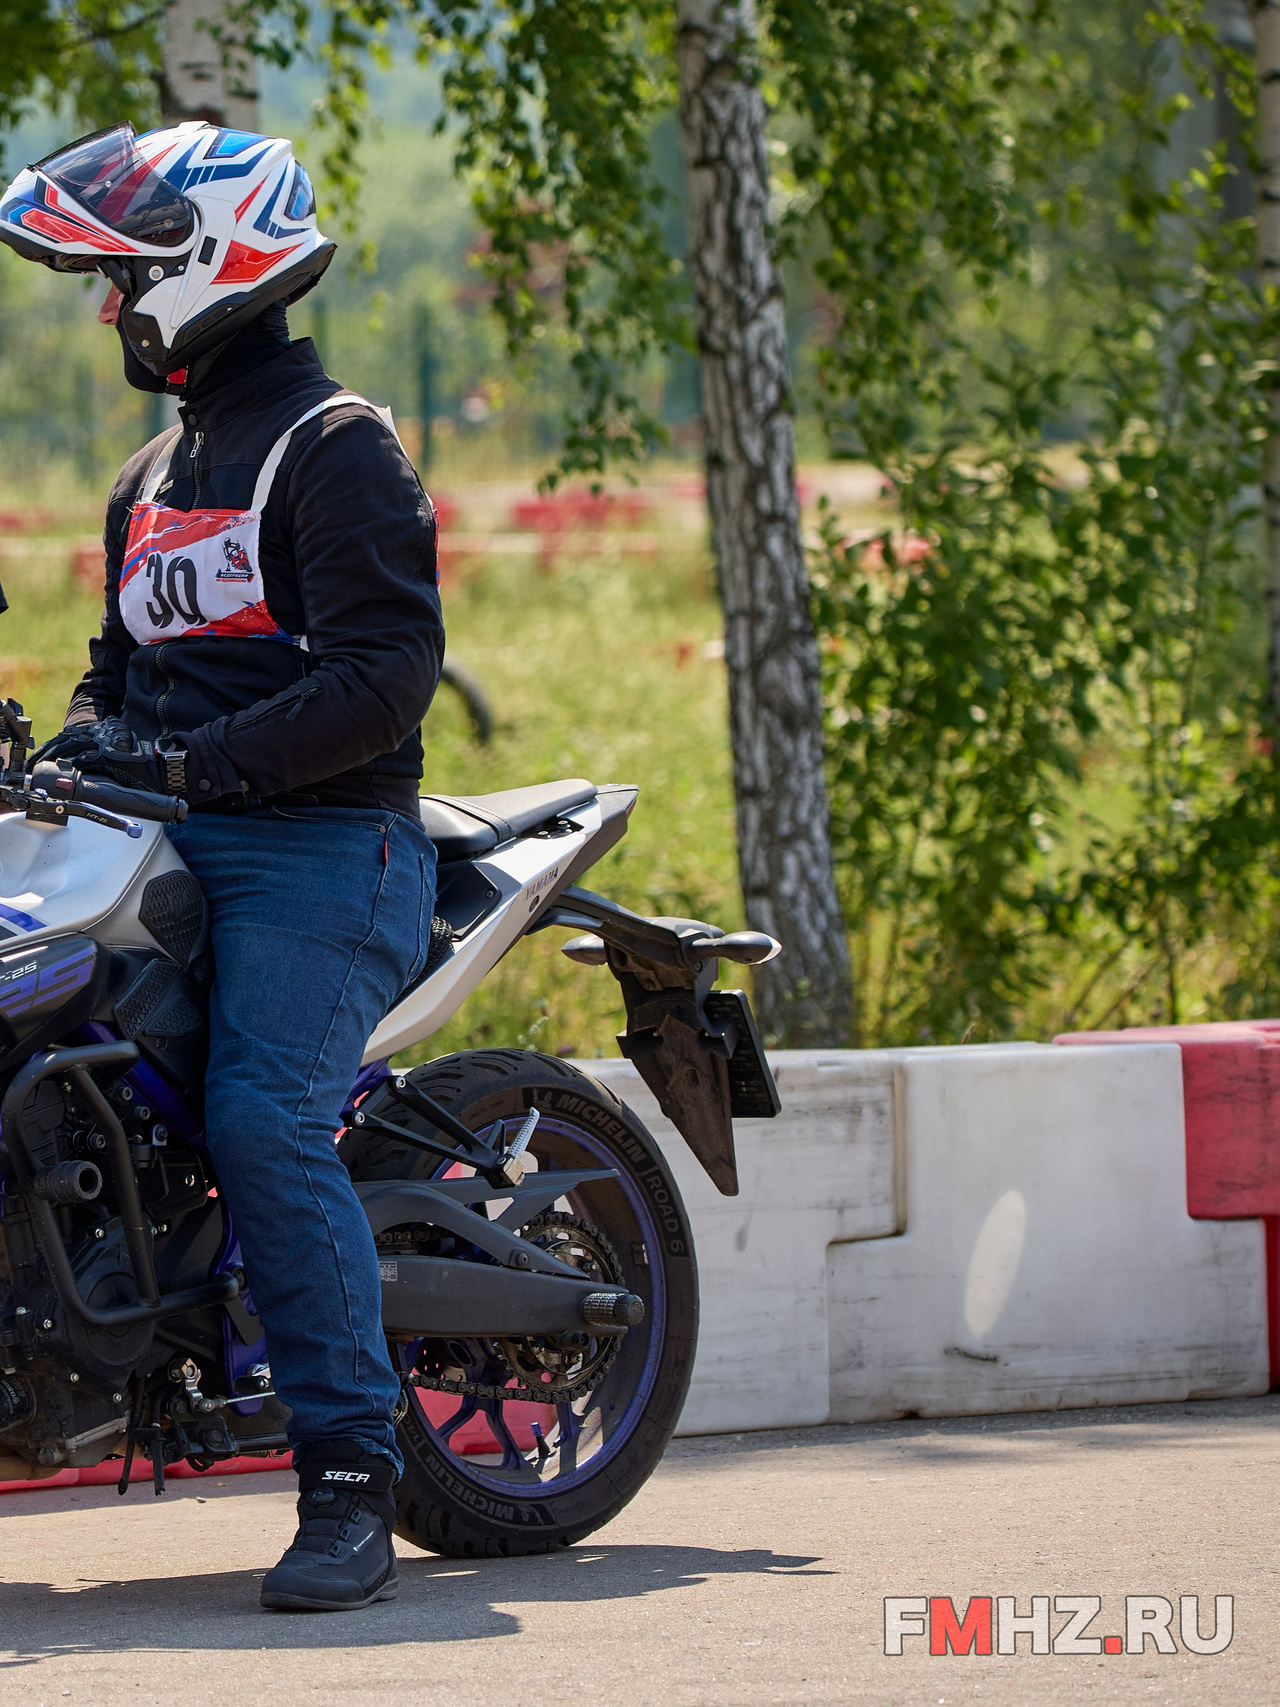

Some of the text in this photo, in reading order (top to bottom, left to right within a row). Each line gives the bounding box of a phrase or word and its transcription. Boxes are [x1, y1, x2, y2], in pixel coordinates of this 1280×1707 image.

[145, 552, 208, 629] 30
[526, 867, 559, 900] YAMAHA
[556, 1094, 684, 1253] MICHELIN ROAD 6
[321, 1470, 371, 1483] SECA
[426, 1452, 513, 1519] MICHELIN
